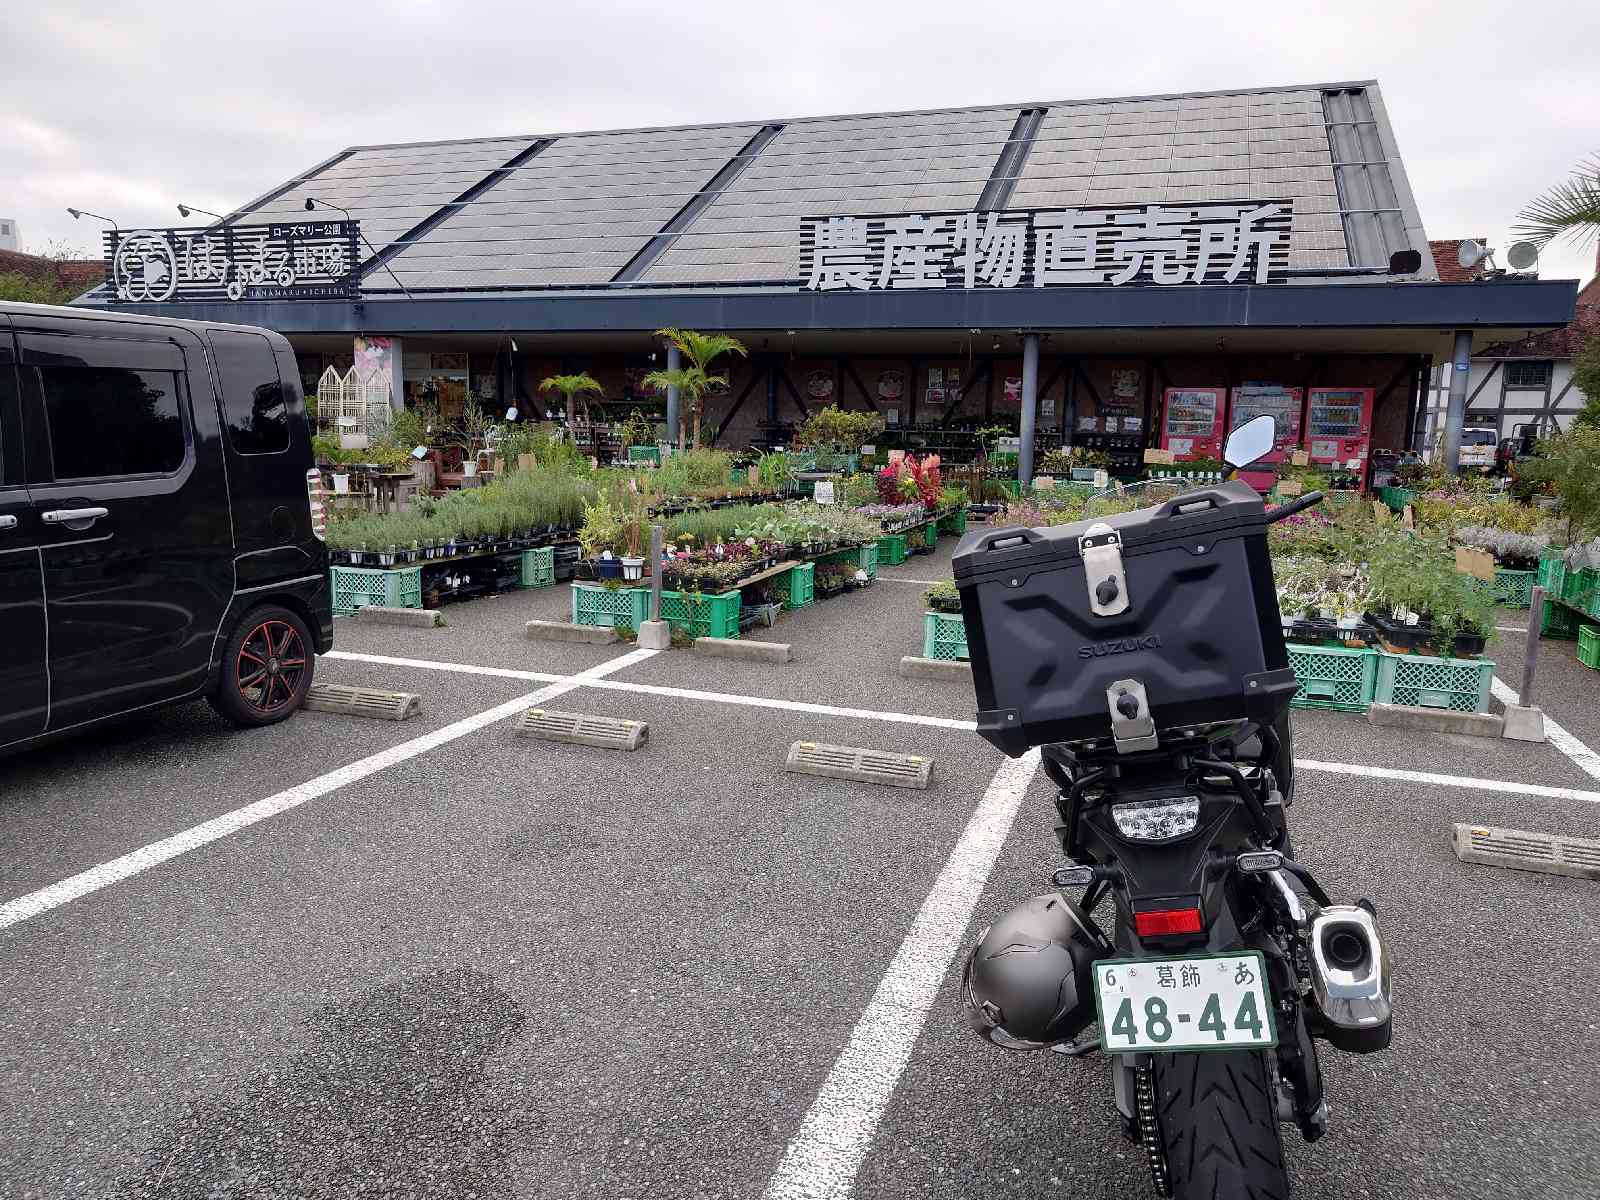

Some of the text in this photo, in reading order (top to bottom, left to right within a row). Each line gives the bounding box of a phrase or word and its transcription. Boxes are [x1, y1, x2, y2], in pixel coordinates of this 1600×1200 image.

[273, 224, 341, 237] ローズマリー公園
[806, 203, 1283, 291] 農産物直売所
[1078, 634, 1161, 659] SUZUKI
[1105, 968, 1117, 987] 6
[1155, 961, 1255, 989] 葛飾 あ
[1111, 991, 1264, 1045] 48-44
